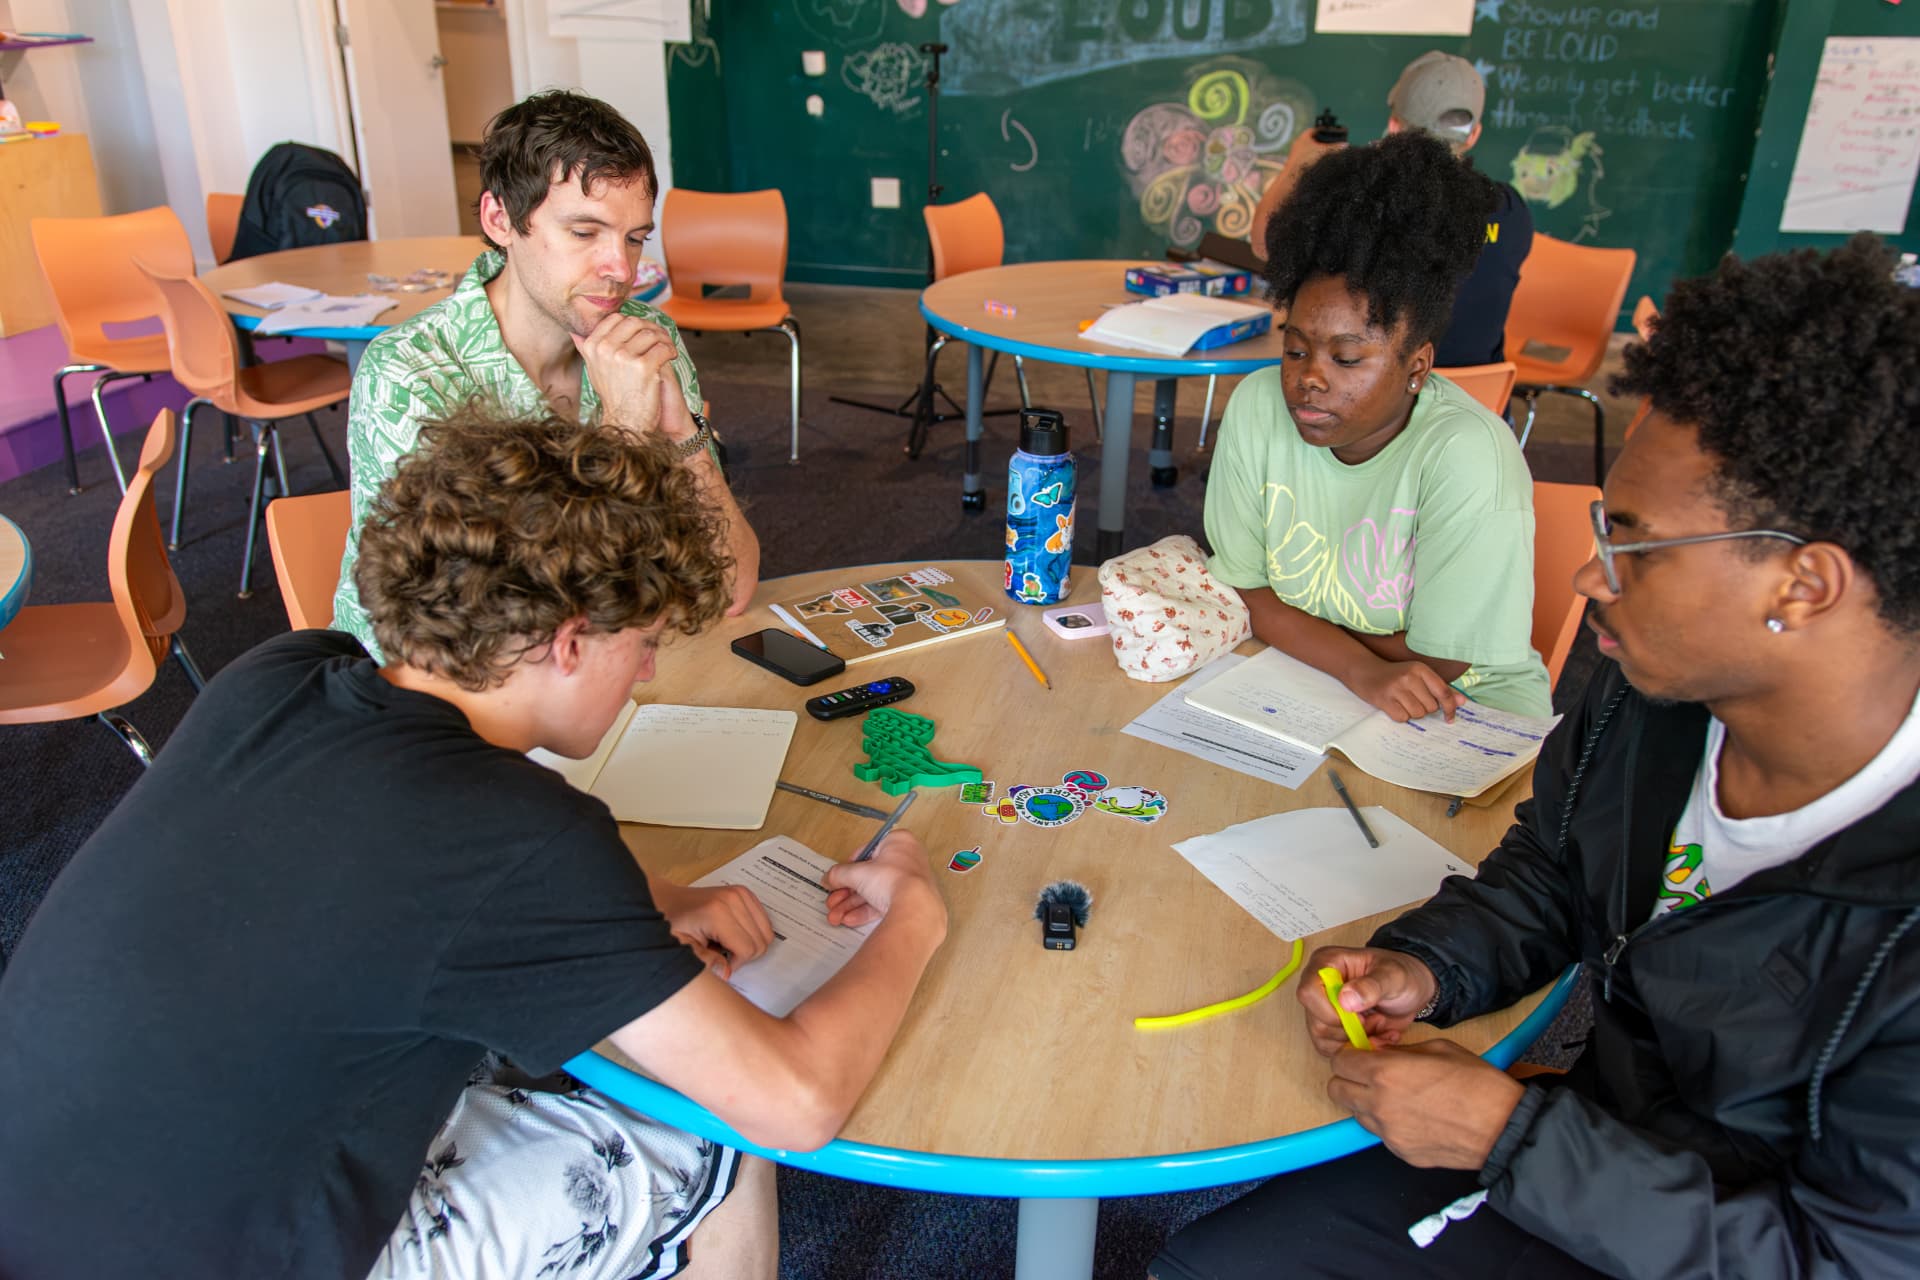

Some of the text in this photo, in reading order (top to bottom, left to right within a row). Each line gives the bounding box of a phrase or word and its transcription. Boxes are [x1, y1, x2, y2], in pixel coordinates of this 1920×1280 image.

[1568, 6, 1602, 32] up
[1606, 7, 1660, 30] and
[1501, 27, 1618, 63] BE LOUD
[1498, 64, 1531, 93] We
[1592, 71, 1641, 100] get
[1652, 71, 1736, 107] better
[1032, 788, 1071, 797] GREAT
